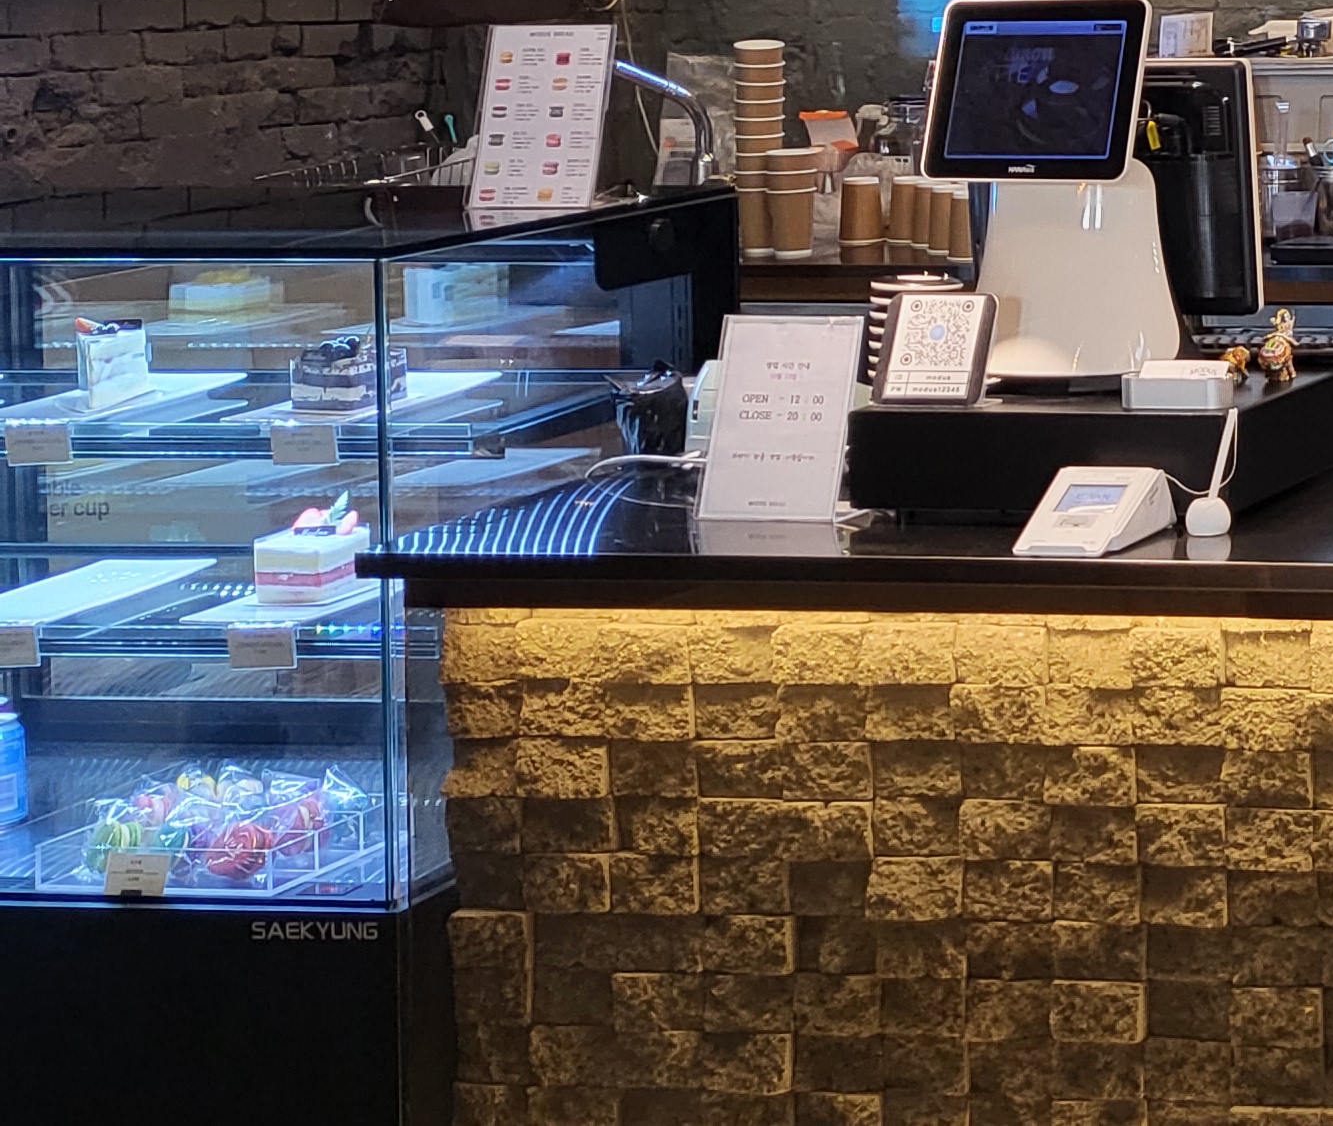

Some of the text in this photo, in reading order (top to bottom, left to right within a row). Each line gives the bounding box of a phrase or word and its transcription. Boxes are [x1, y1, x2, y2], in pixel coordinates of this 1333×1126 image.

[742, 394, 769, 404] OPEN
[790, 394, 801, 405] 12
[812, 394, 824, 405] 00
[739, 410, 772, 420] CLOSE
[786, 411, 798, 421] 20
[810, 411, 822, 422] 00
[74, 501, 109, 521] cup
[251, 921, 379, 941] SAEKYUNG
